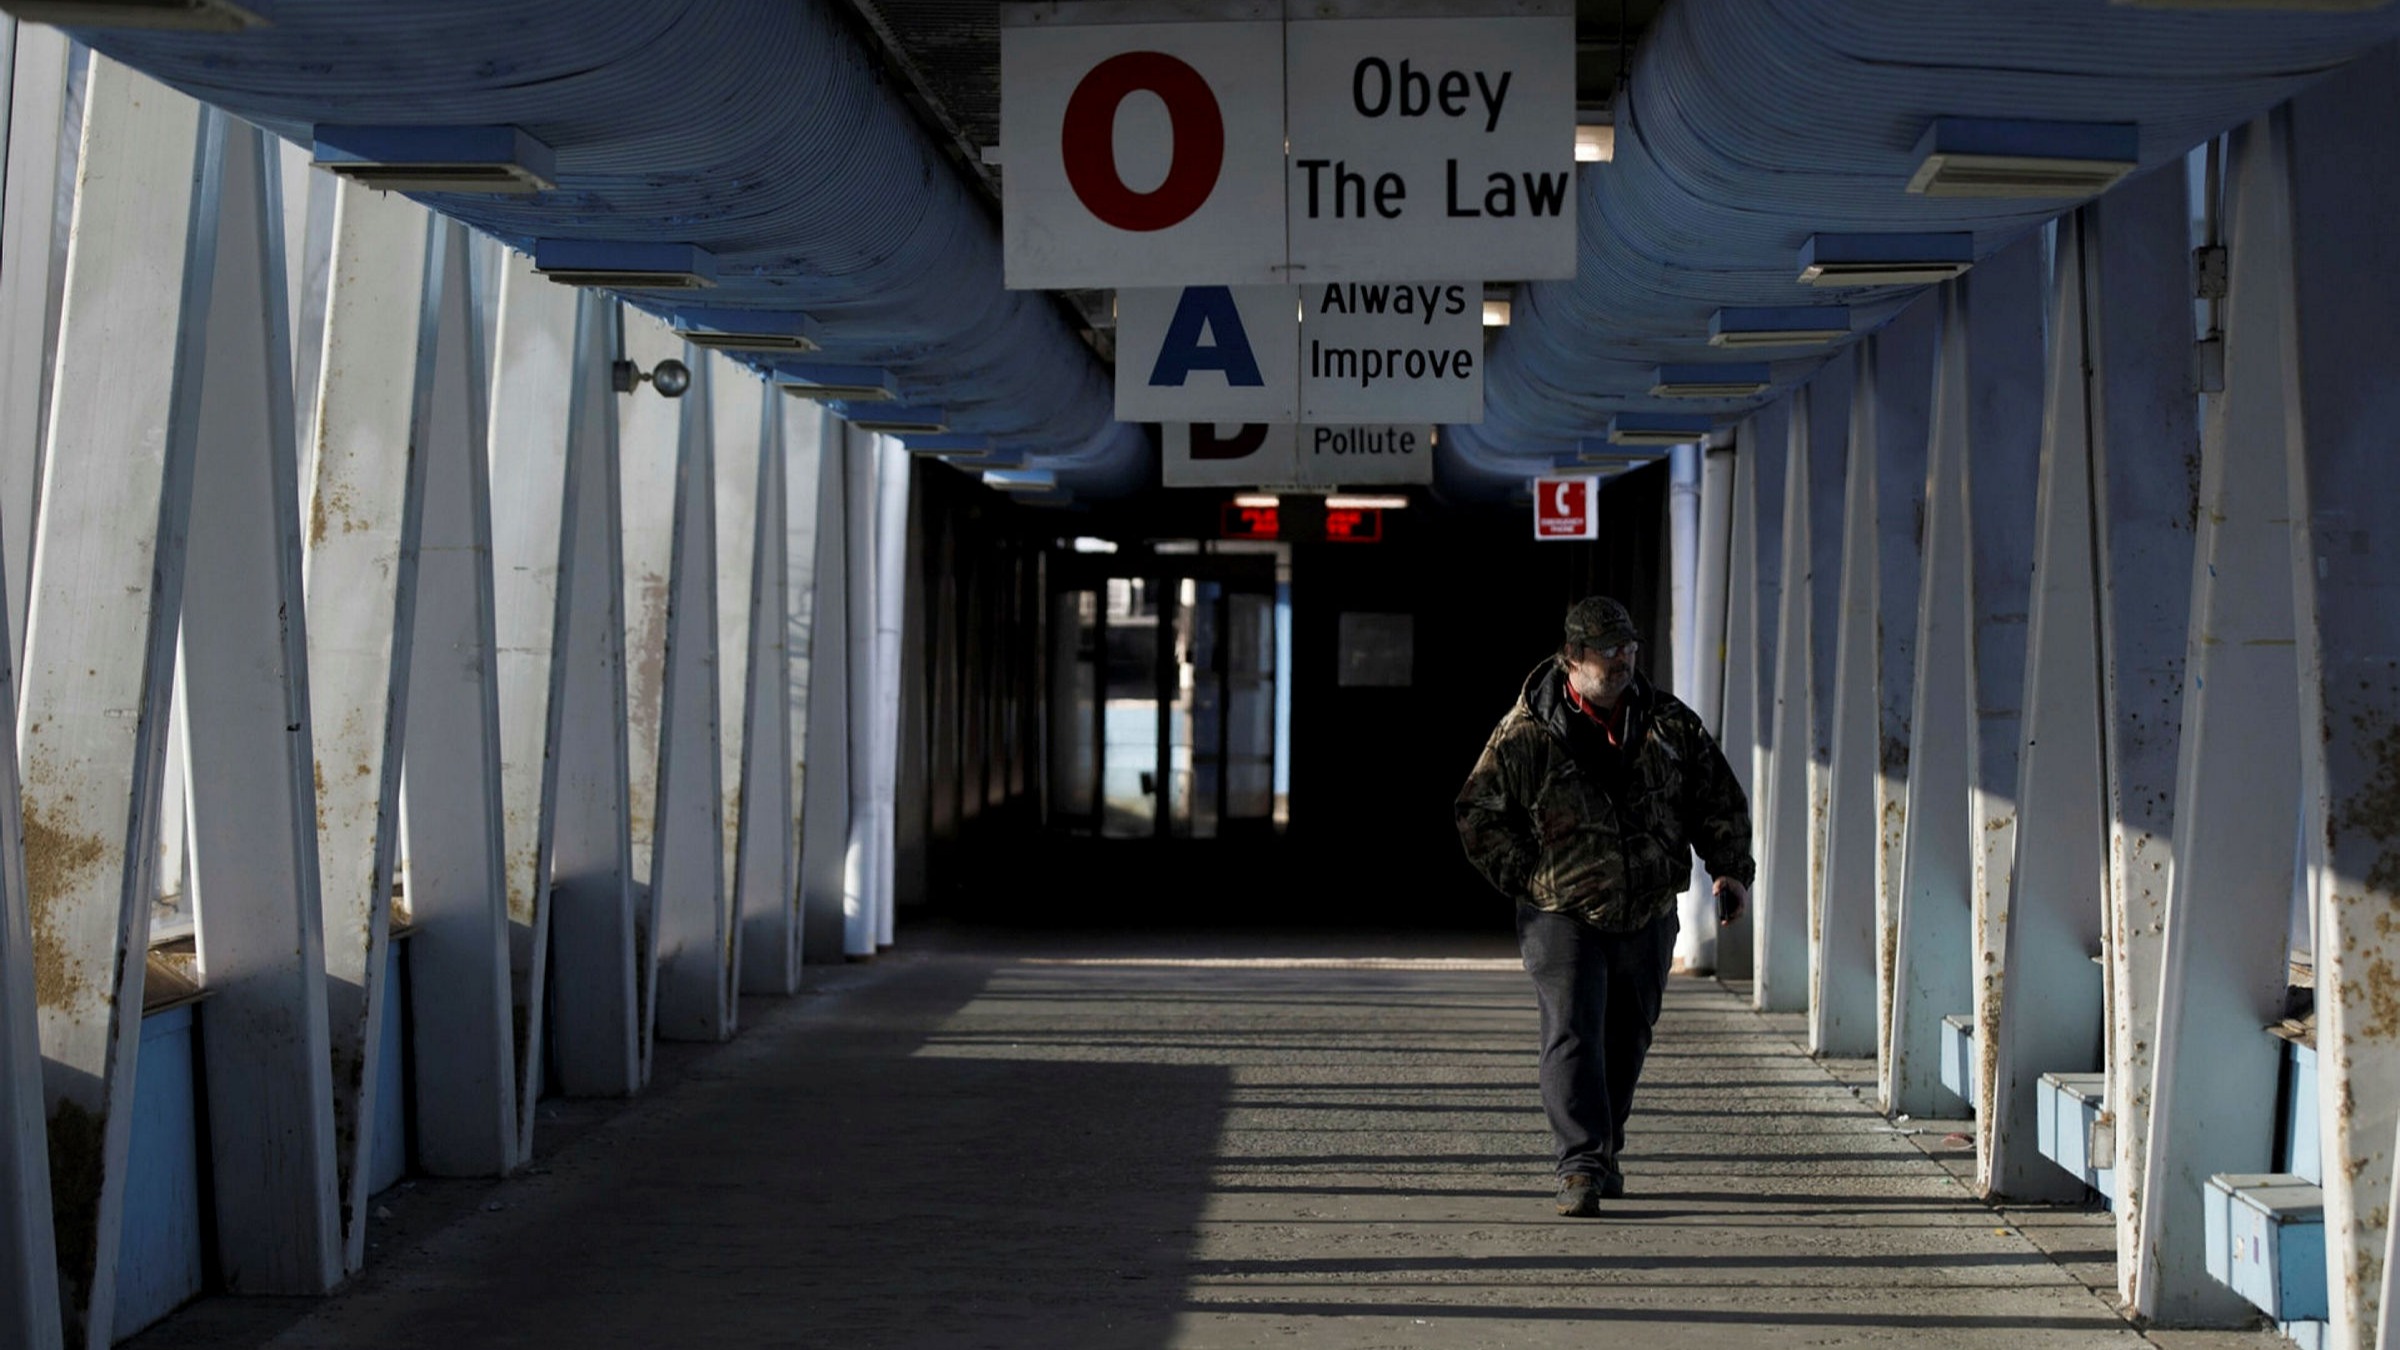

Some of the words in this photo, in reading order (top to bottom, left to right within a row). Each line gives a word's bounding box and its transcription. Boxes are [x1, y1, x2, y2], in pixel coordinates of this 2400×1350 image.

[1353, 57, 1512, 132] Obey
[1062, 51, 1224, 232] O
[1297, 160, 1406, 219] The
[1447, 159, 1568, 218] Law
[1320, 283, 1466, 325] Always
[1148, 285, 1265, 387] A
[1311, 340, 1473, 387] Improve
[1315, 427, 1415, 455] Pollute
